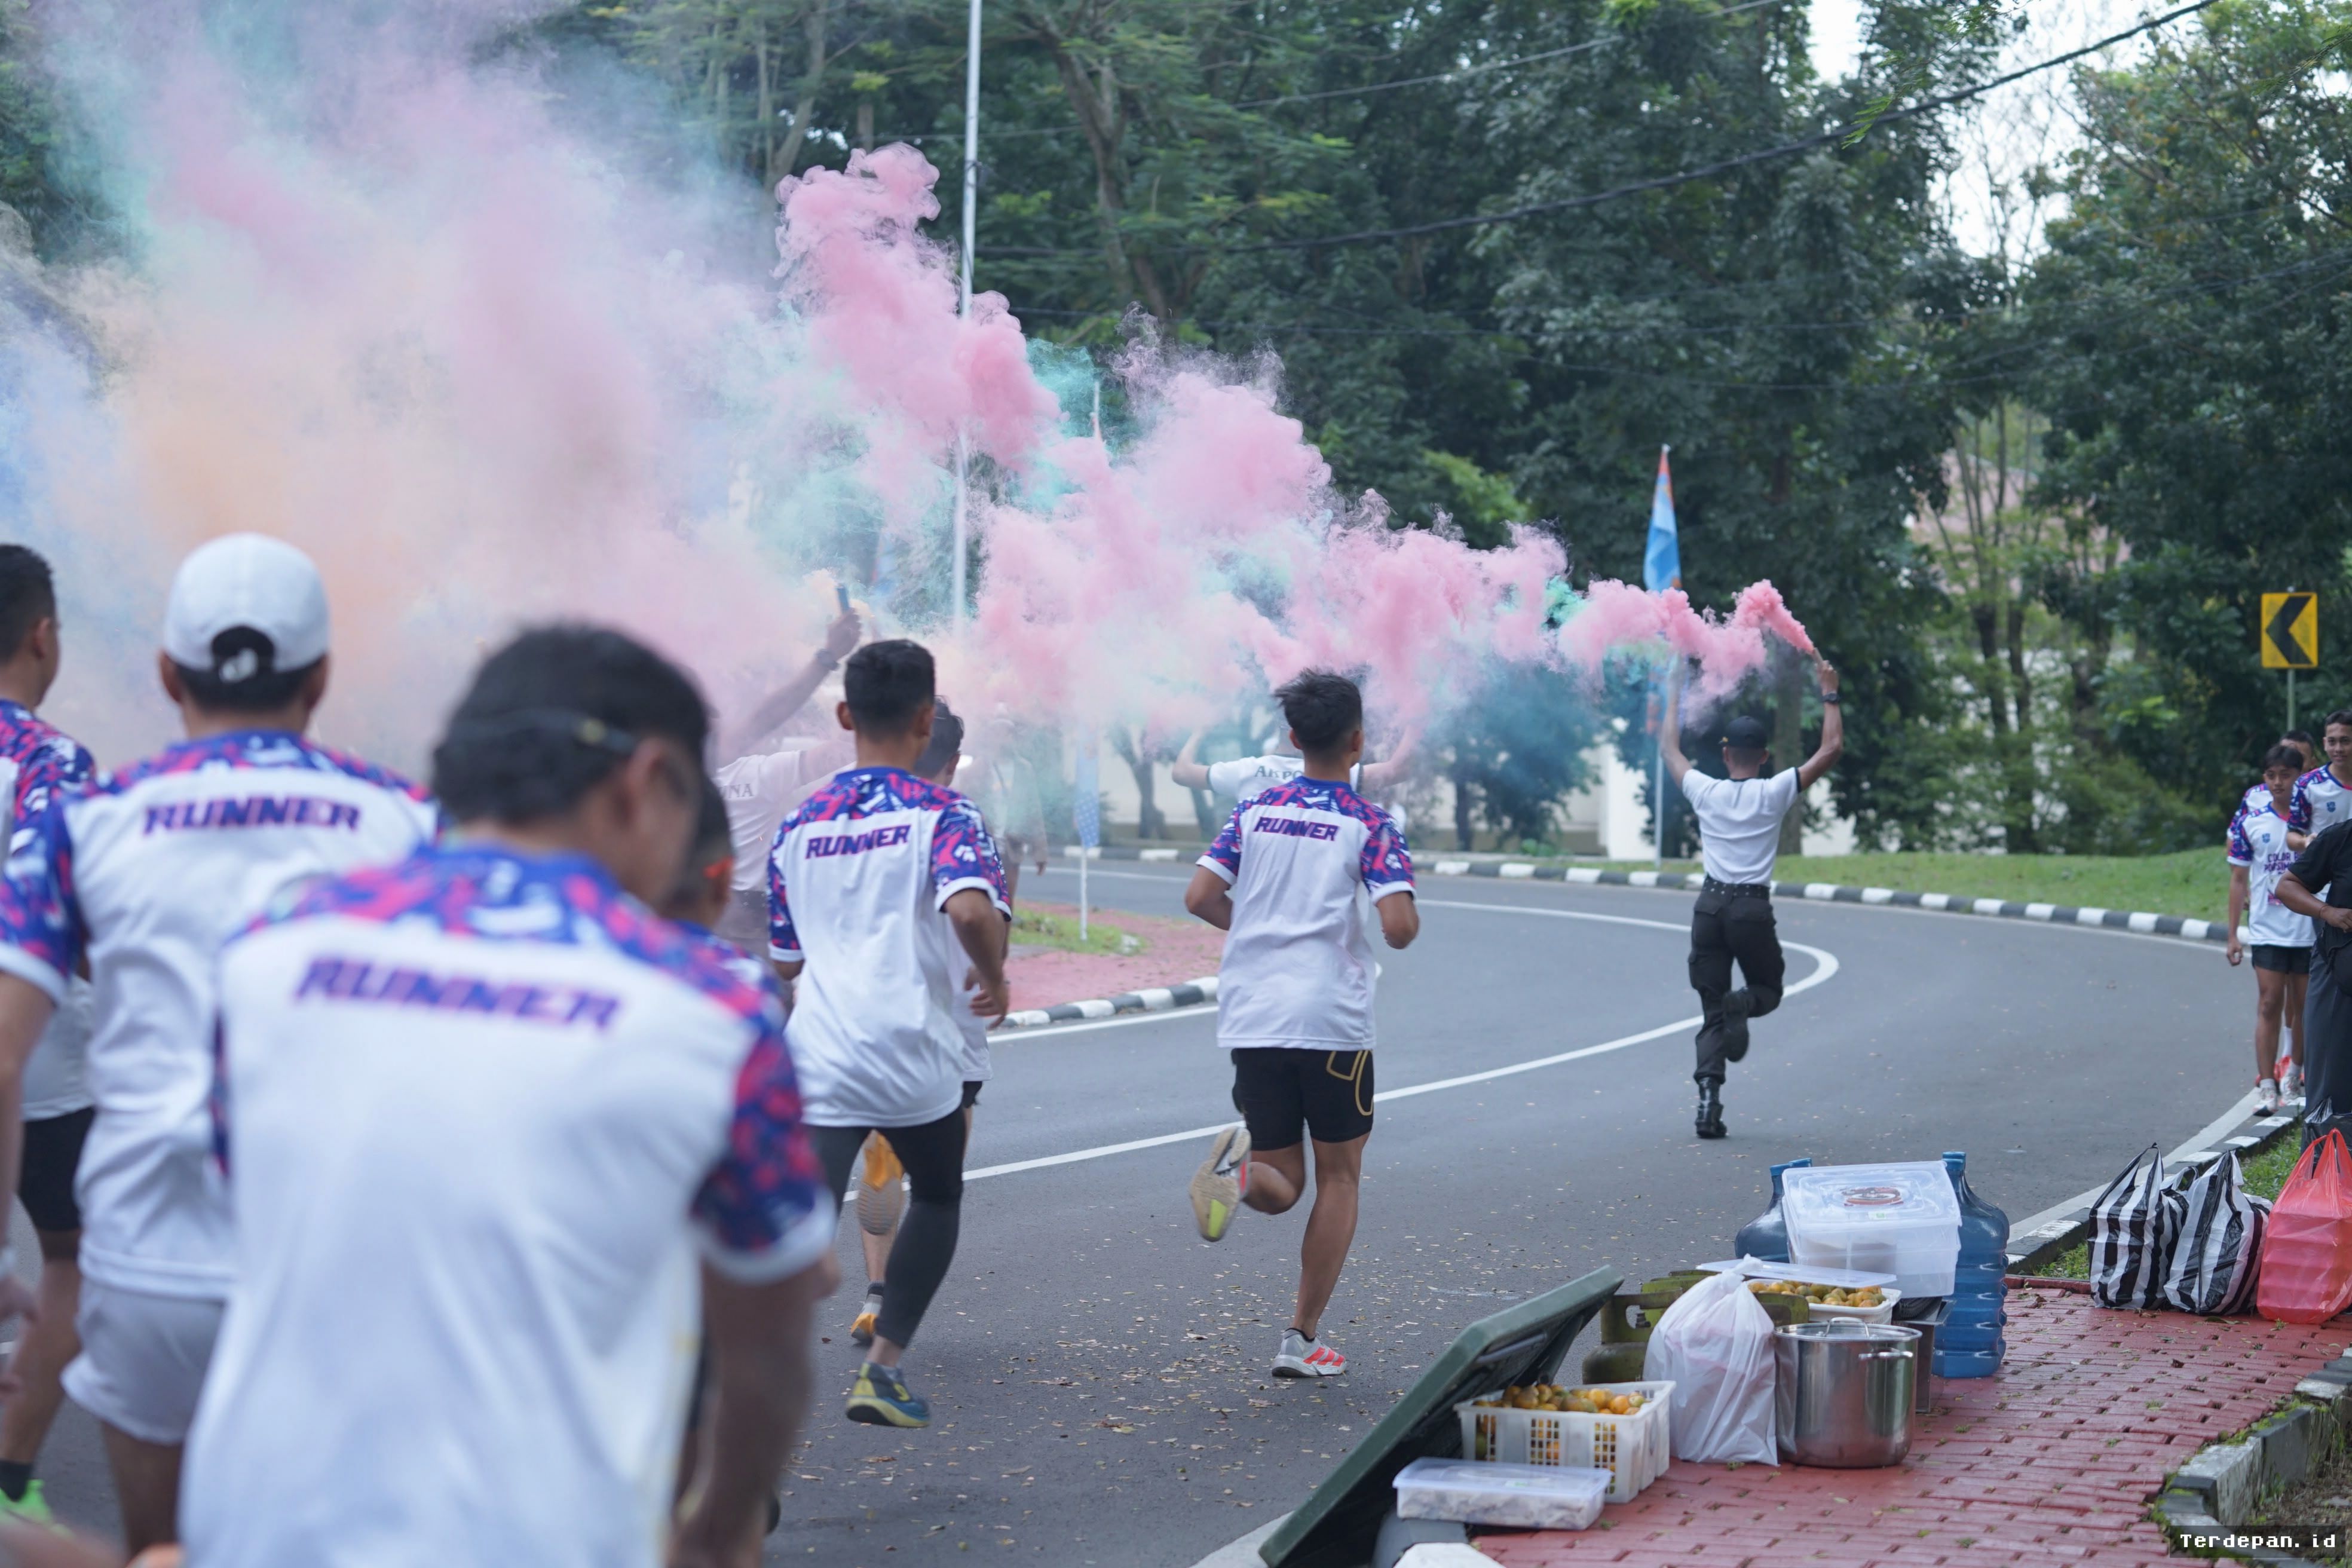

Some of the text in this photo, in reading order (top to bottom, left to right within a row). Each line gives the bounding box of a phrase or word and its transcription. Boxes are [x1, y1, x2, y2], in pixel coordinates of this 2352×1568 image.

[143, 797, 361, 836] RUNNER
[1254, 817, 1341, 841] RUNNER
[805, 825, 911, 859] RUNNER
[2268, 852, 2290, 862] COLOR
[293, 958, 618, 1029] RUNNER
